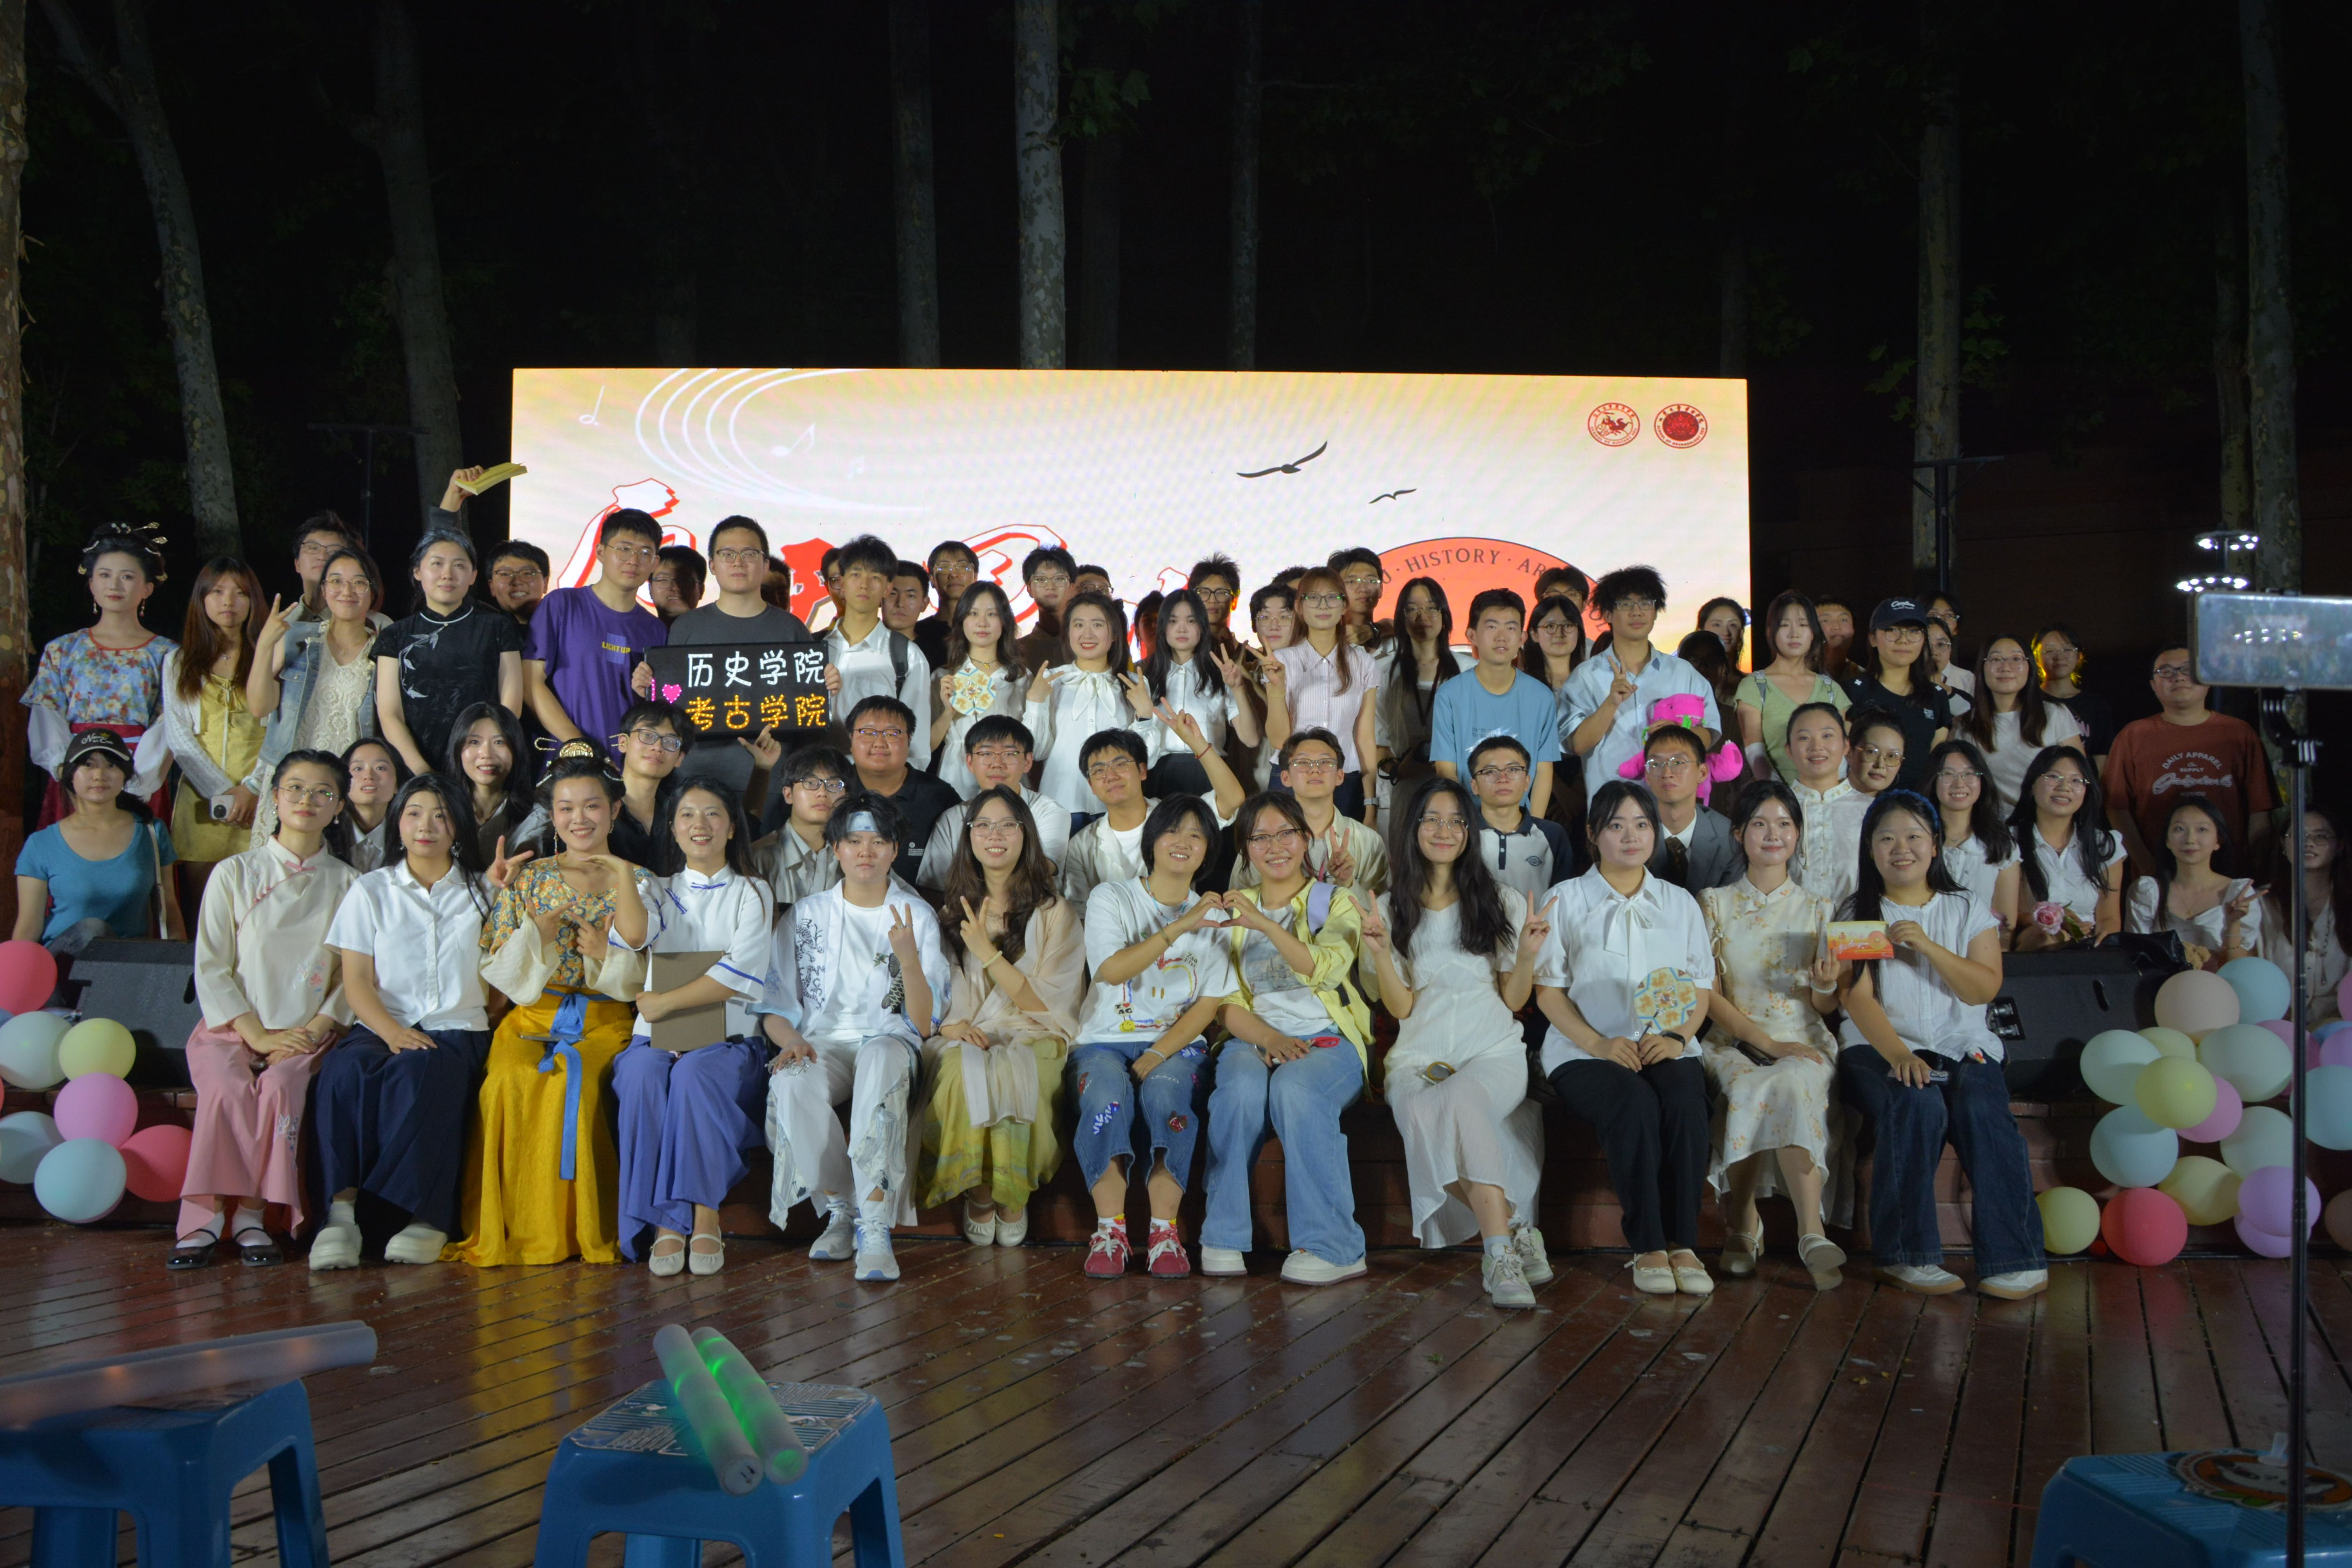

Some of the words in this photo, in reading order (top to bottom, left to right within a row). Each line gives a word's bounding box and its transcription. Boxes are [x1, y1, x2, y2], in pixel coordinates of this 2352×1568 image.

[1405, 548, 1501, 573] HISTORY
[602, 641, 620, 652] LIGHT
[687, 648, 826, 688] 历史学院
[685, 693, 826, 731] 考古学院
[2162, 752, 2183, 770] DAILY
[2186, 752, 2223, 770] APPAREL
